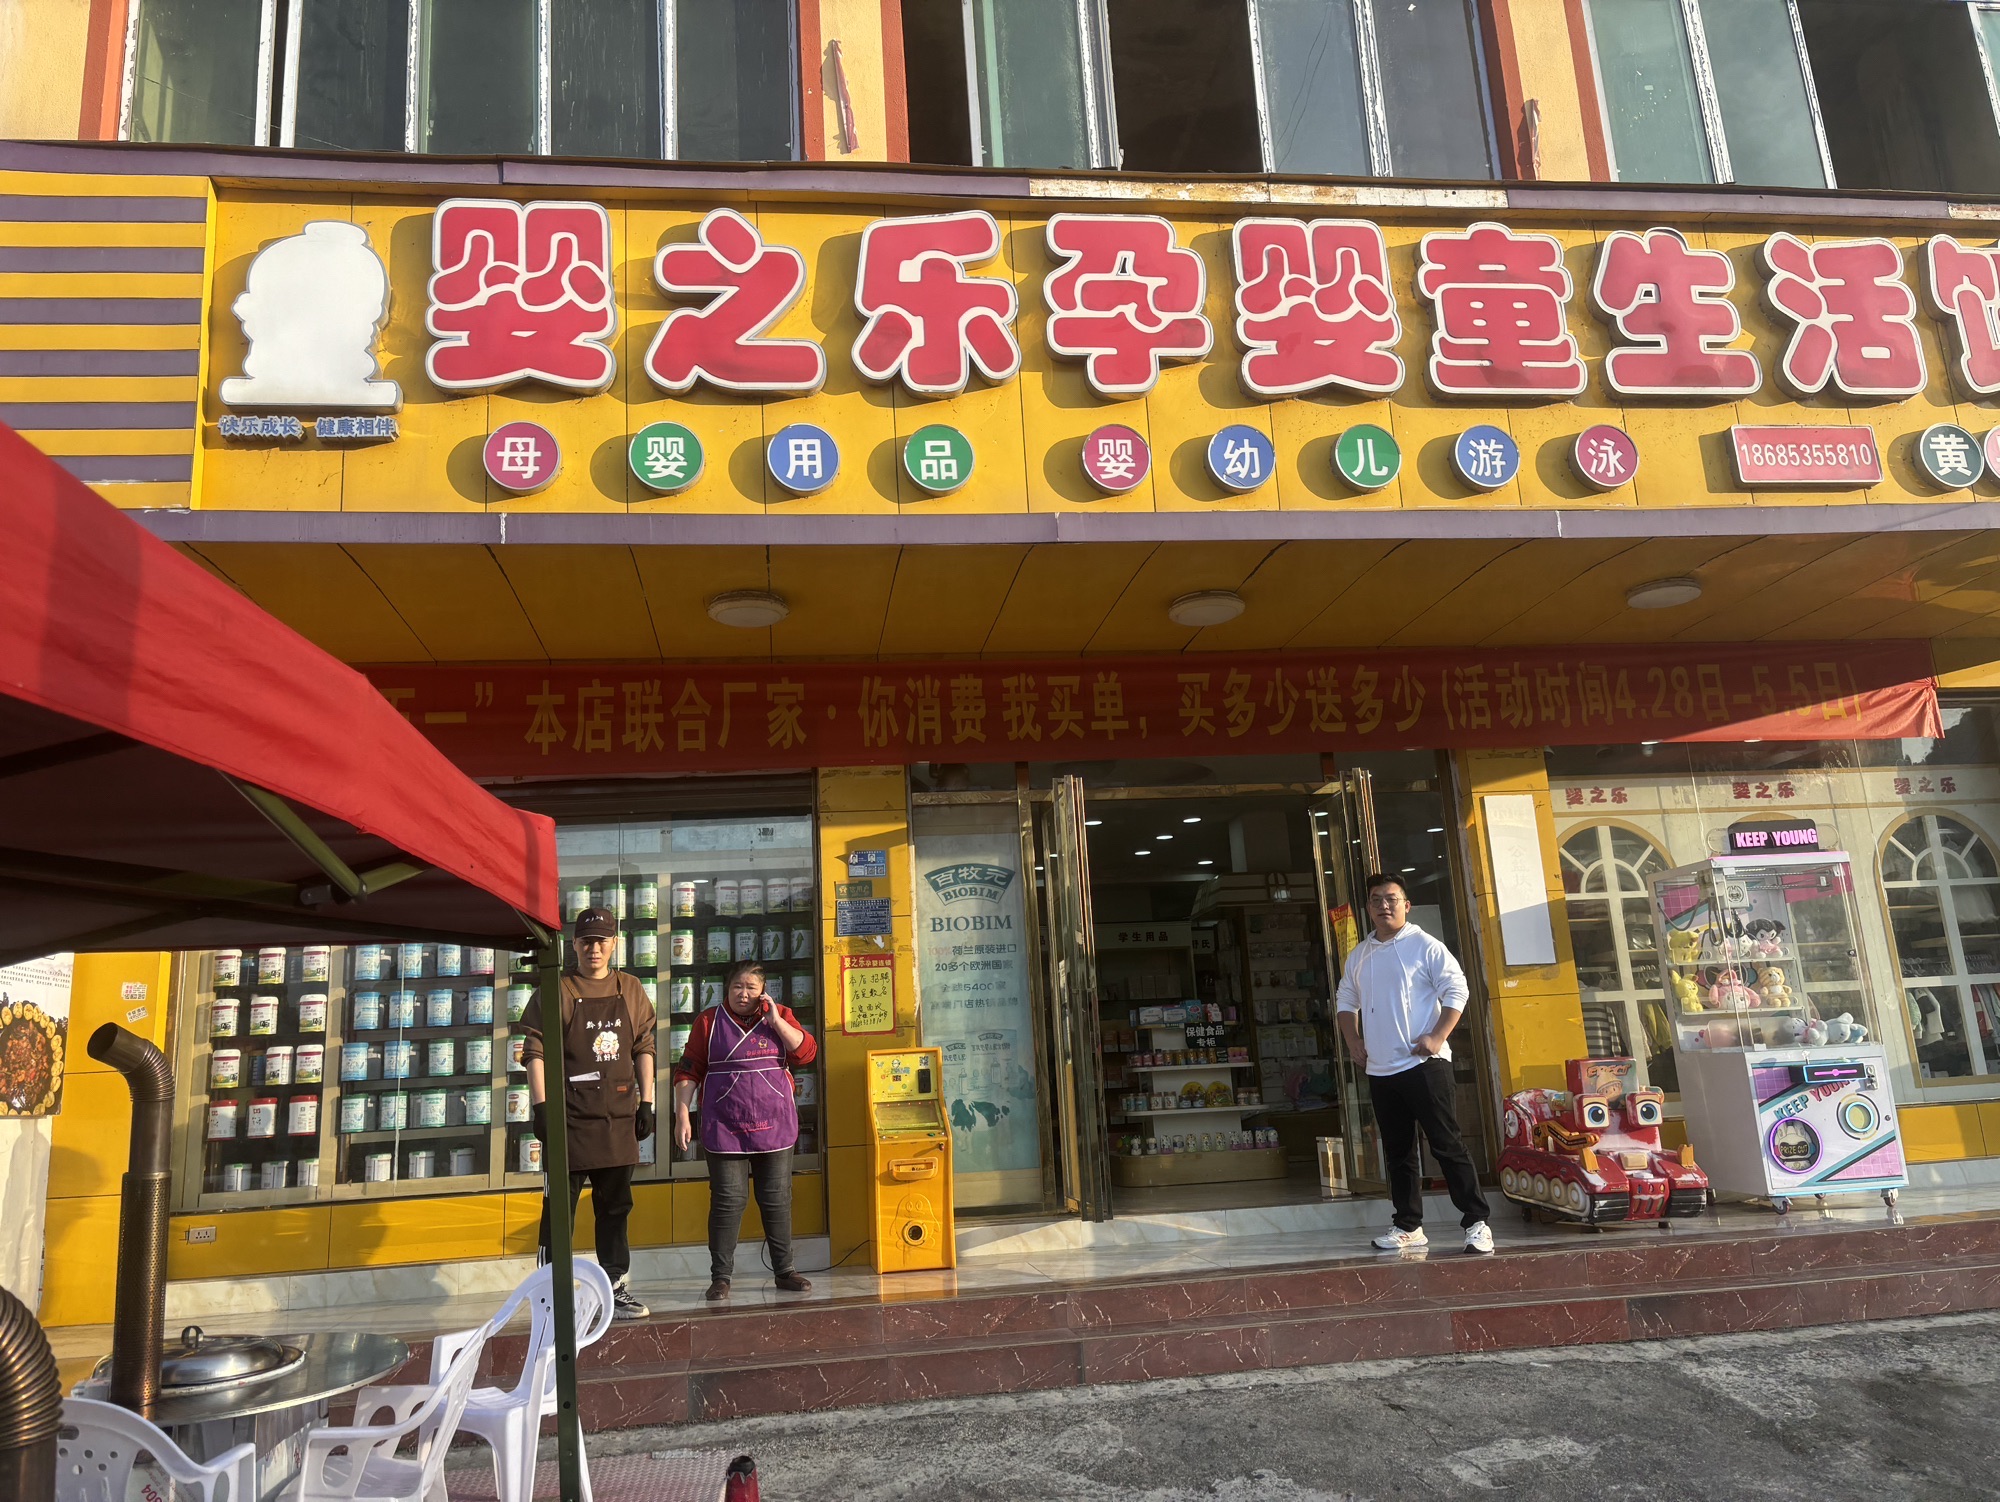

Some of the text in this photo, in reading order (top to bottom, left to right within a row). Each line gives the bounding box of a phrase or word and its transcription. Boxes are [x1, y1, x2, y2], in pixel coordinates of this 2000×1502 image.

[218, 415, 395, 438] 快乐成长 健康相伴
[1741, 443, 1872, 466] 18685355810
[1566, 776, 1957, 806] 婴之乐 婴之乐 婴之乐
[1735, 828, 1818, 848] KEEP YOUNG
[931, 866, 1008, 887] 百牧元
[942, 887, 999, 901] BIOBIM
[930, 915, 1012, 932] BIOBIM
[1118, 931, 1168, 942] 学生用品
[935, 959, 1013, 972] 20多个欧洲国家
[1186, 1025, 1225, 1038] 保健食品
[1196, 1037, 1217, 1047] 专柜
[1773, 1094, 1809, 1120] KEEP
[1780, 1144, 1808, 1155] PRIZE OUT
